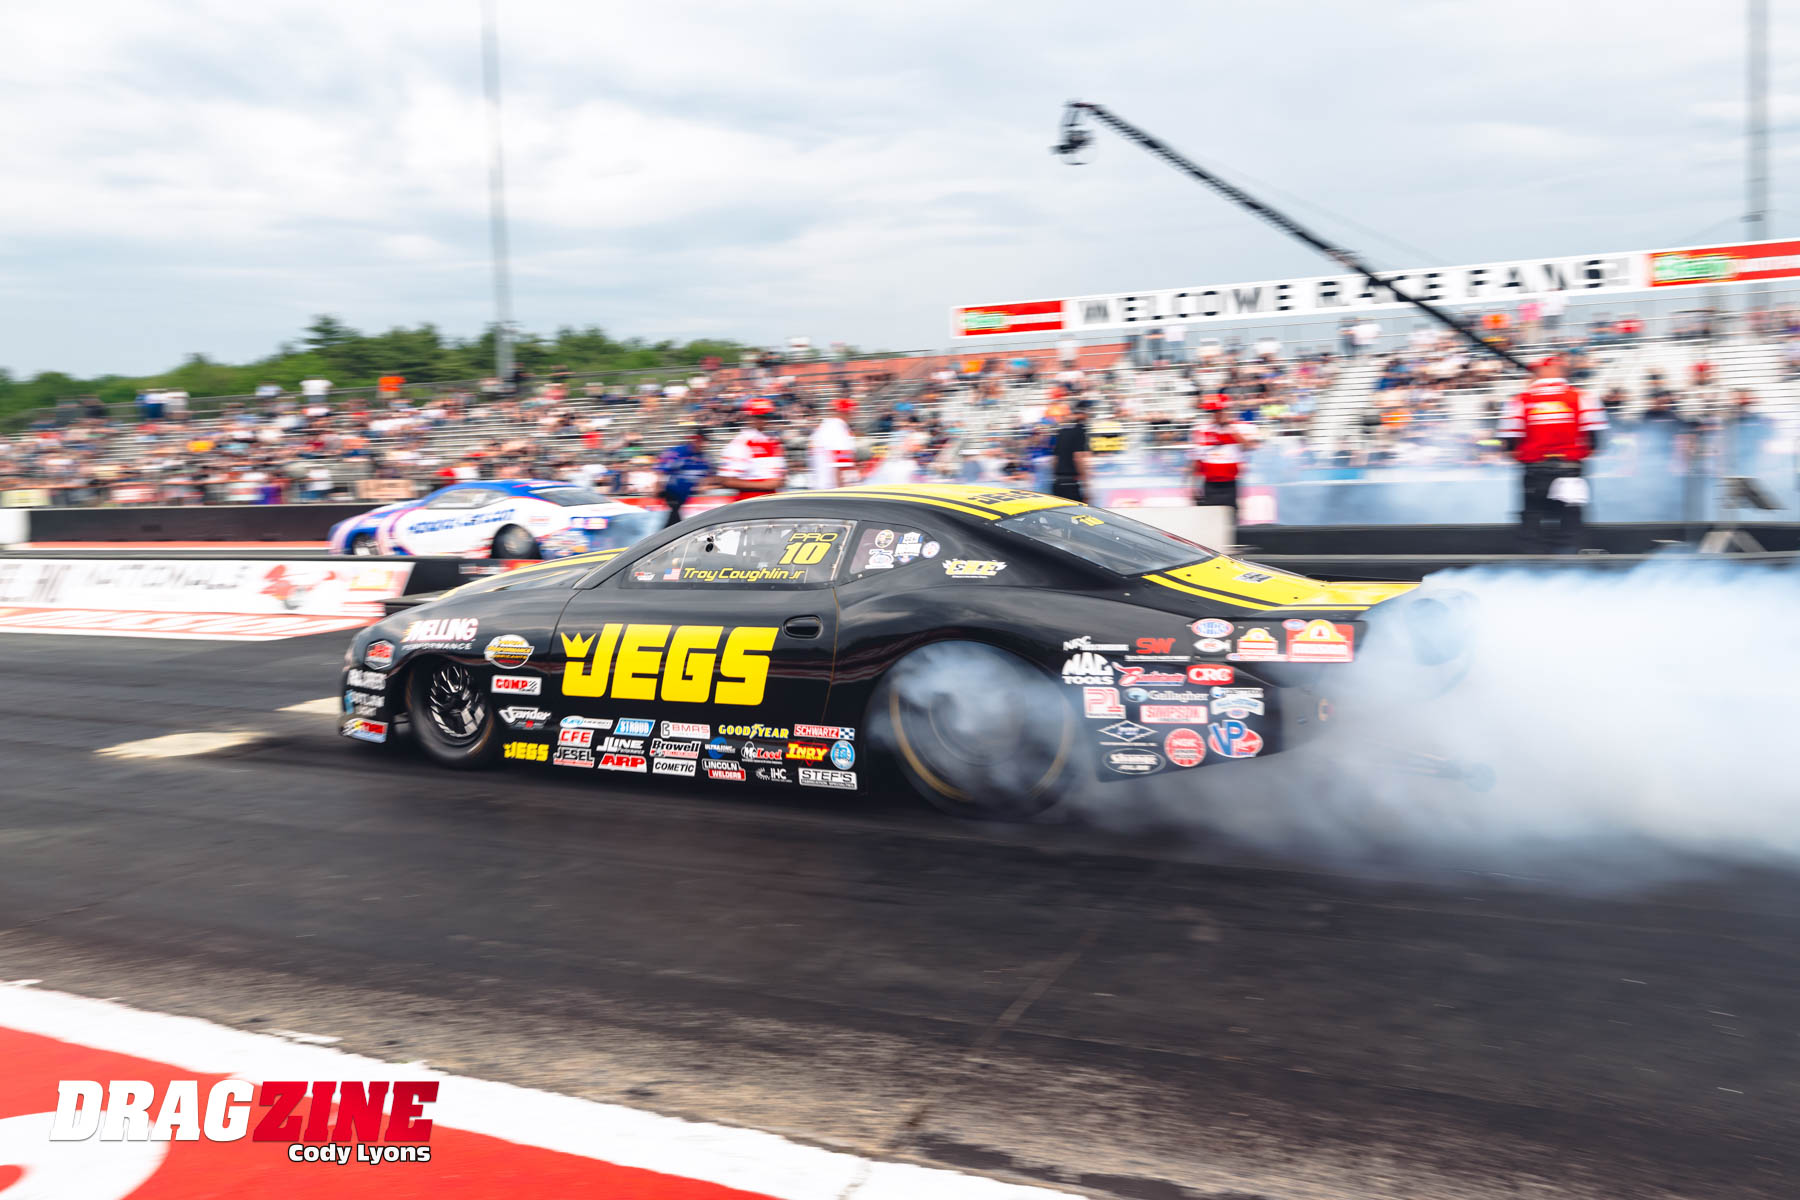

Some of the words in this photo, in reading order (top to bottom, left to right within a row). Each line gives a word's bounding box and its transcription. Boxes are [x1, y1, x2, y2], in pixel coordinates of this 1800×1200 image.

[789, 532, 838, 542] PRO
[778, 542, 832, 565] 10
[684, 567, 718, 582] Troy
[718, 567, 788, 582] Coughlin
[404, 618, 479, 642] MELLING
[402, 642, 473, 651] PERFORMANCE
[1136, 637, 1176, 654] SW
[561, 623, 779, 706] JEGS
[1062, 652, 1114, 675] MAC
[1062, 676, 1114, 685] TOOLS
[1188, 668, 1231, 681] CRC
[496, 678, 528, 689] COMP
[561, 730, 591, 743] CFE
[718, 724, 789, 739] GOODYEAR
[795, 726, 838, 737] SCHWARTZ
[1211, 721, 1244, 755] VP
[596, 736, 644, 752] JUNE
[652, 740, 700, 752] Browell
[503, 741, 549, 761] JEGS
[554, 747, 594, 761] JESEL
[743, 746, 782, 760] McLeod
[601, 755, 646, 768] ARP
[655, 762, 694, 773] COMETIC
[704, 760, 738, 770] LINCOLN
[711, 769, 743, 779] WELDERS
[770, 768, 787, 779] IHC
[802, 769, 852, 783] STEF'S
